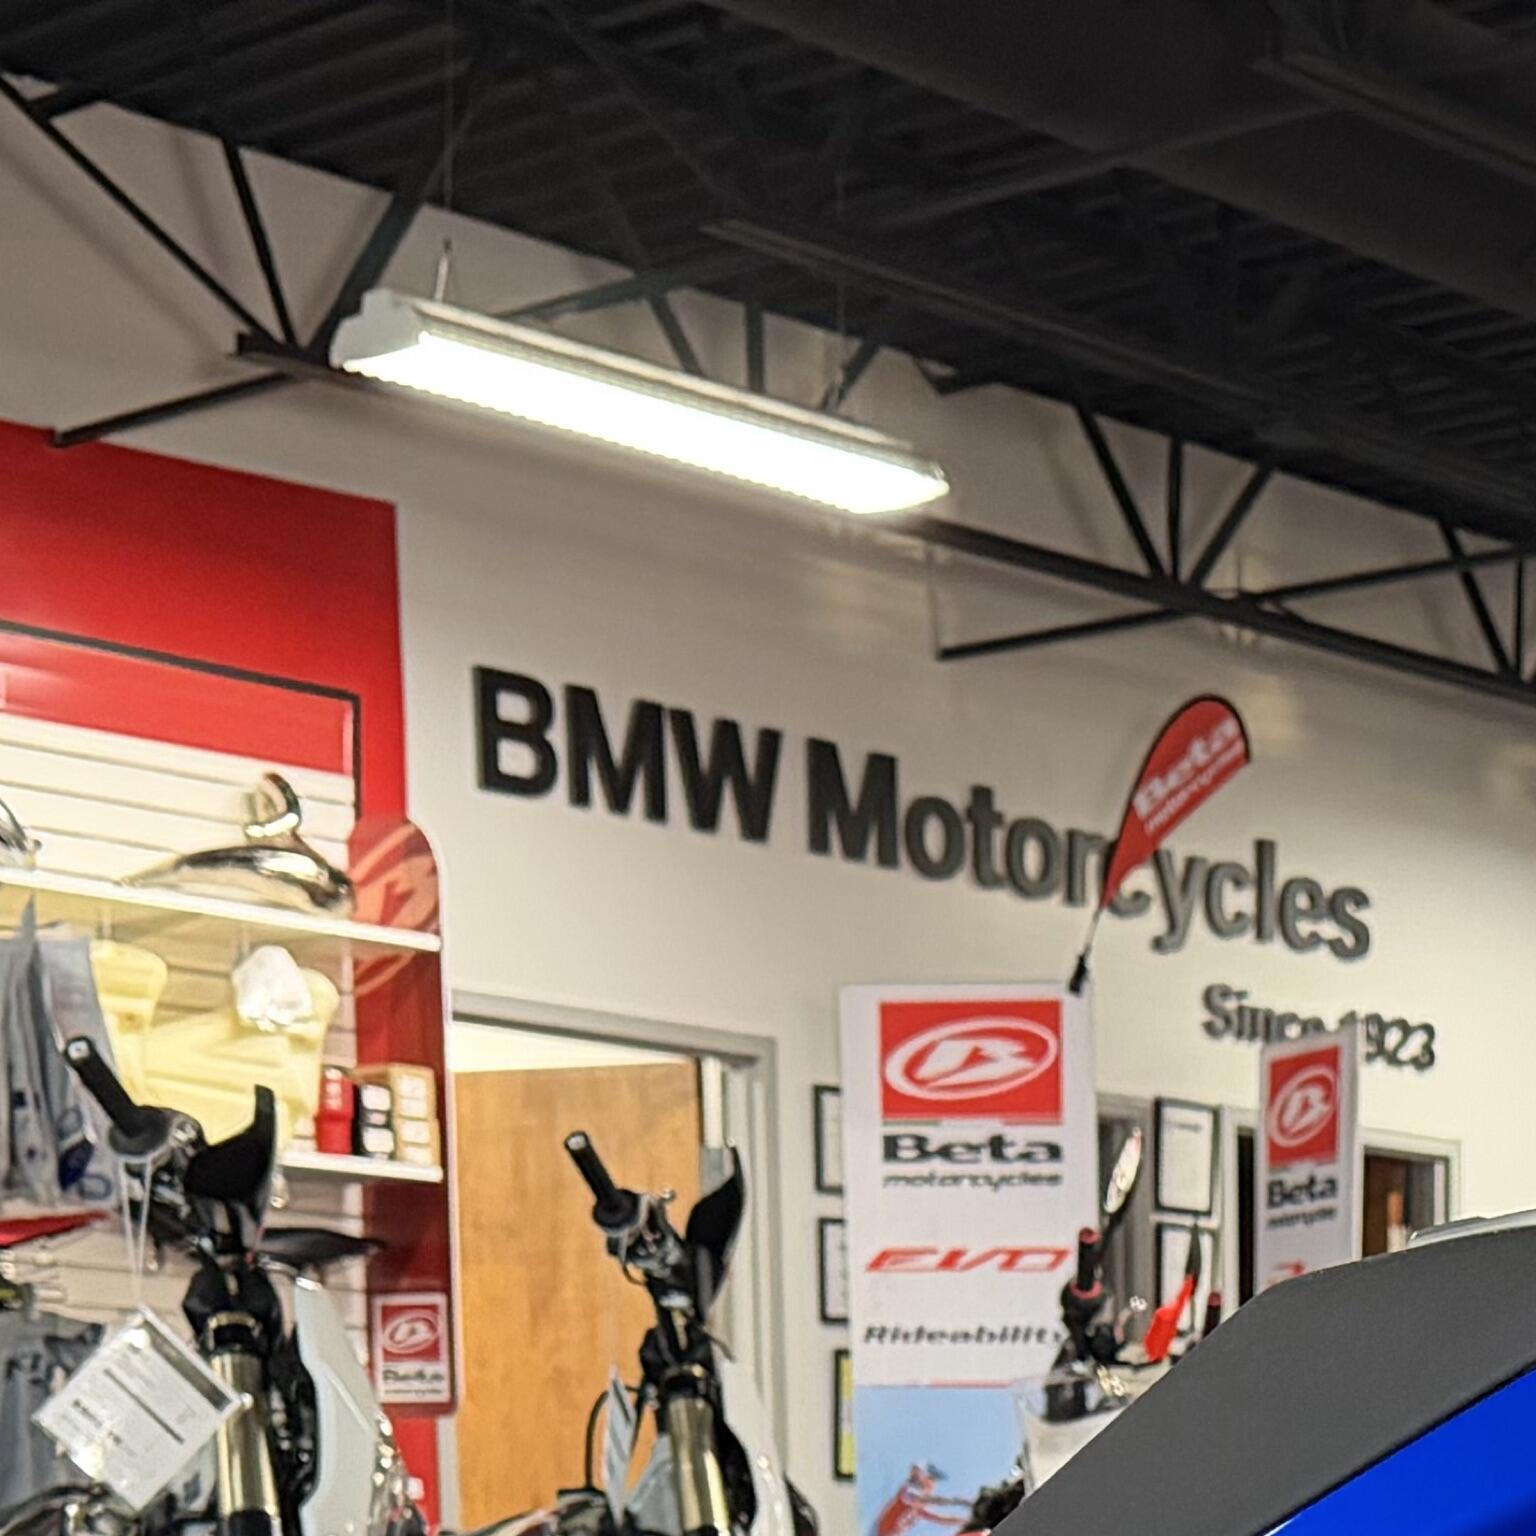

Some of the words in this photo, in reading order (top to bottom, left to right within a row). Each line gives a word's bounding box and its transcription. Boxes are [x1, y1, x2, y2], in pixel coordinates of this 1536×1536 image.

[471, 664, 782, 845] BMW
[1131, 716, 1238, 821] Beta
[881, 1133, 1064, 1164] Beta
[881, 1170, 1064, 1193] motorcycles
[1267, 1175, 1338, 1209] Beta
